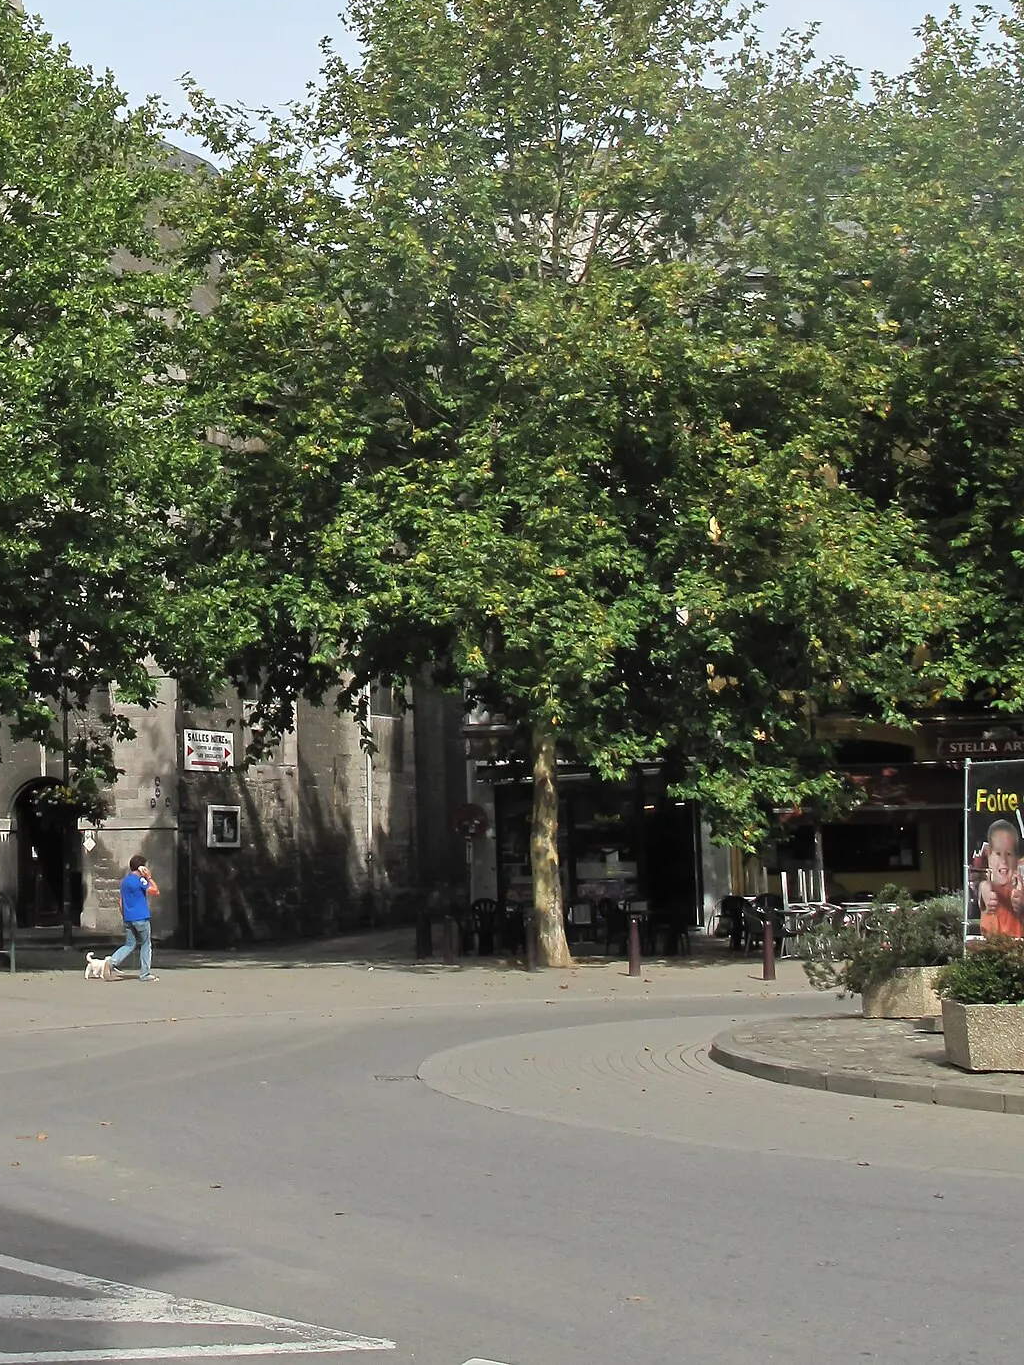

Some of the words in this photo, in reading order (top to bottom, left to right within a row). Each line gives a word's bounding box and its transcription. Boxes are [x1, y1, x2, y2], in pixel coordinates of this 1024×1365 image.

[187, 733, 209, 742] SALLES
[949, 742, 998, 753] STELLA
[976, 788, 1018, 812] Foire
